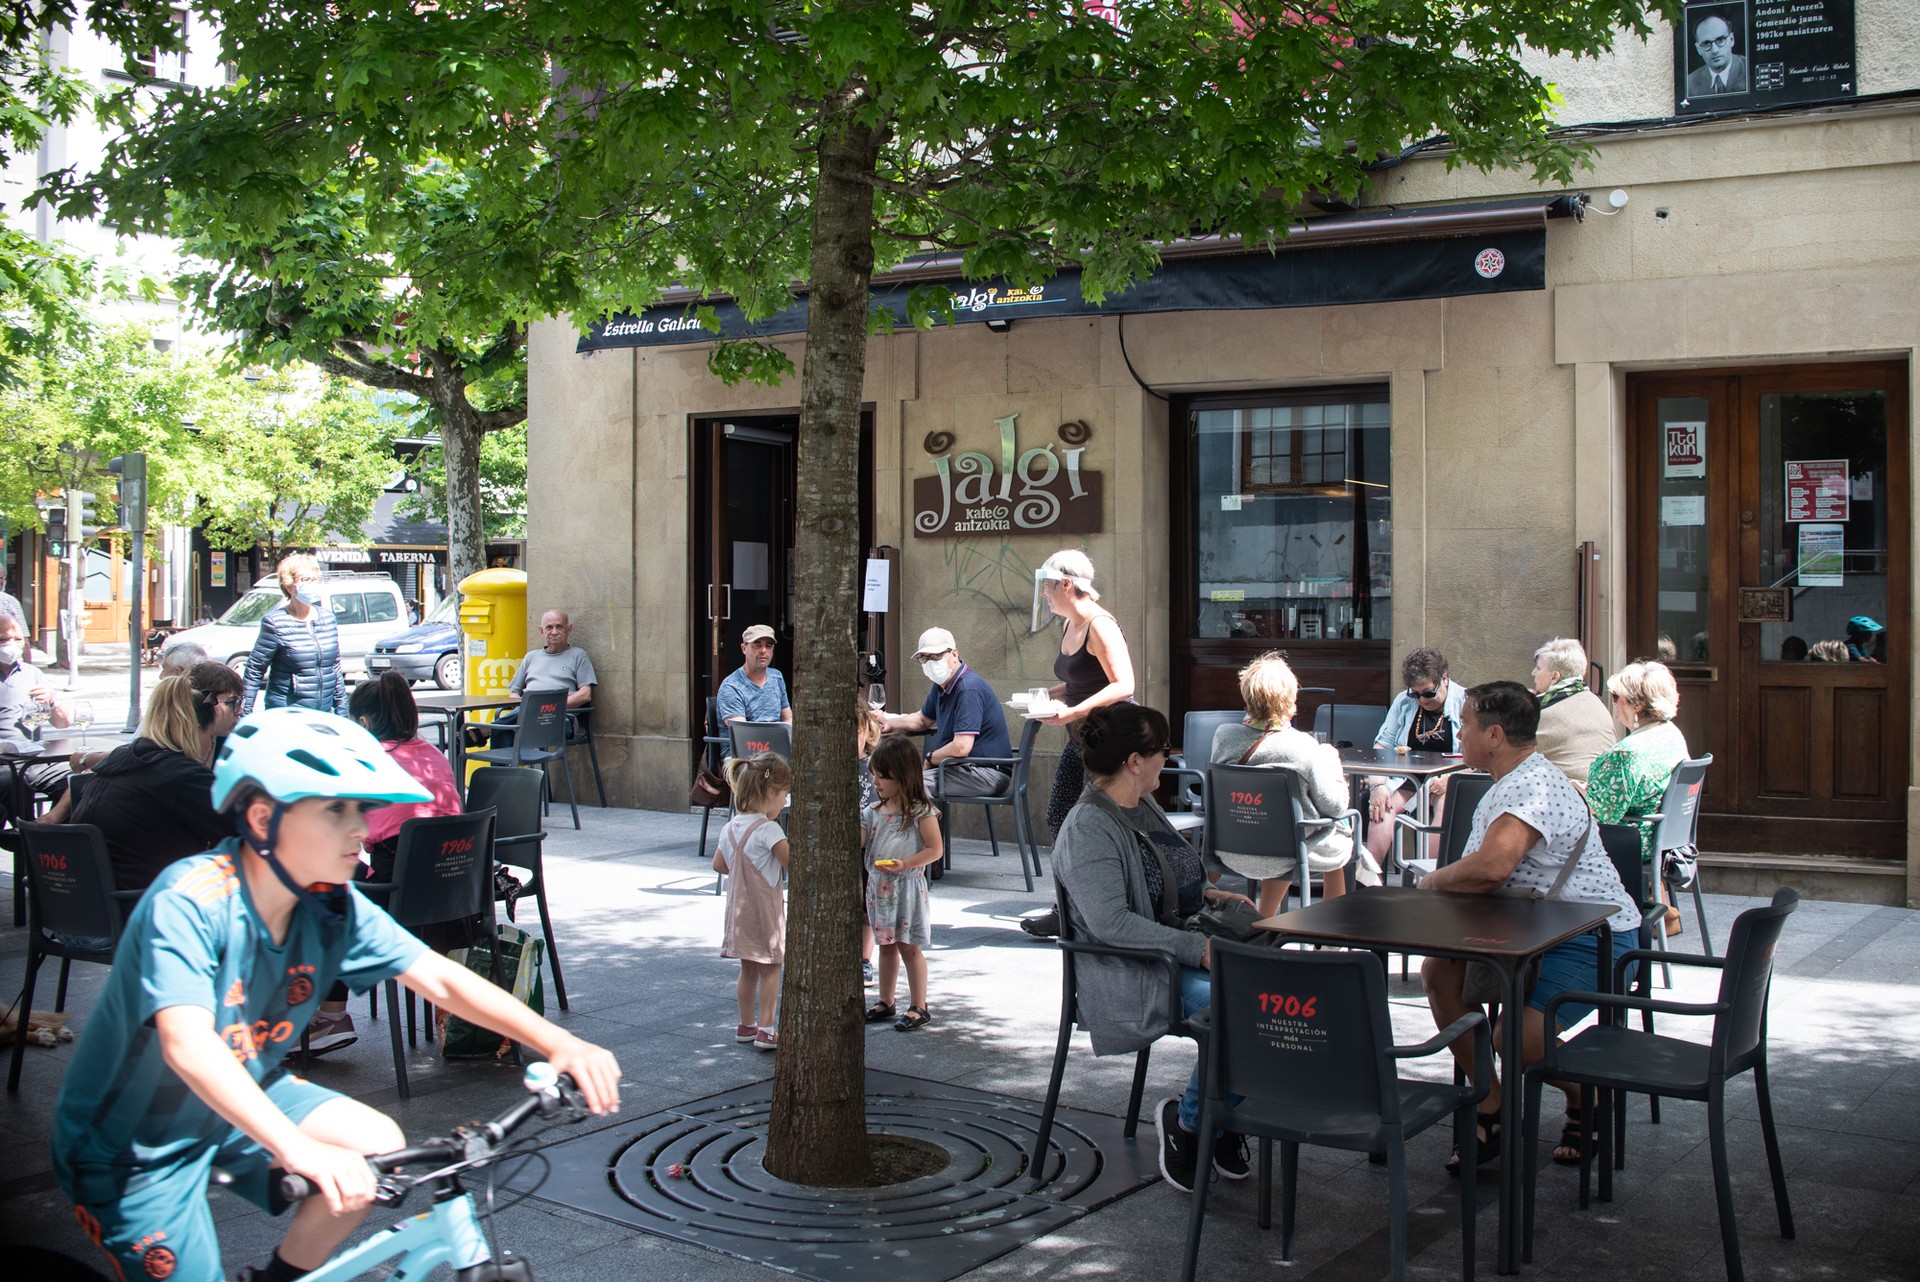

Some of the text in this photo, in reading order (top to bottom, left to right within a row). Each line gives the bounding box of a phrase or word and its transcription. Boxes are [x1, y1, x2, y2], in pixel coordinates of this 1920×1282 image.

[1755, 3, 1824, 16] Andoni Arozena
[1755, 15, 1823, 28] Gomendio jauna
[1756, 26, 1833, 39] 1907ko maiatzaren
[602, 319, 654, 337] Estrella
[915, 412, 1093, 534] jalgi
[954, 518, 1010, 532] antzokia
[315, 551, 436, 562] AVENIDA TABERNA
[746, 741, 770, 752] 1906
[1230, 791, 1263, 806] 1906
[441, 835, 476, 856] 1906
[38, 852, 68, 870] 1906
[1258, 992, 1317, 1018] 1906
[1271, 1018, 1308, 1028] NUESTRA
[1271, 1041, 1314, 1052] PERSONAL
